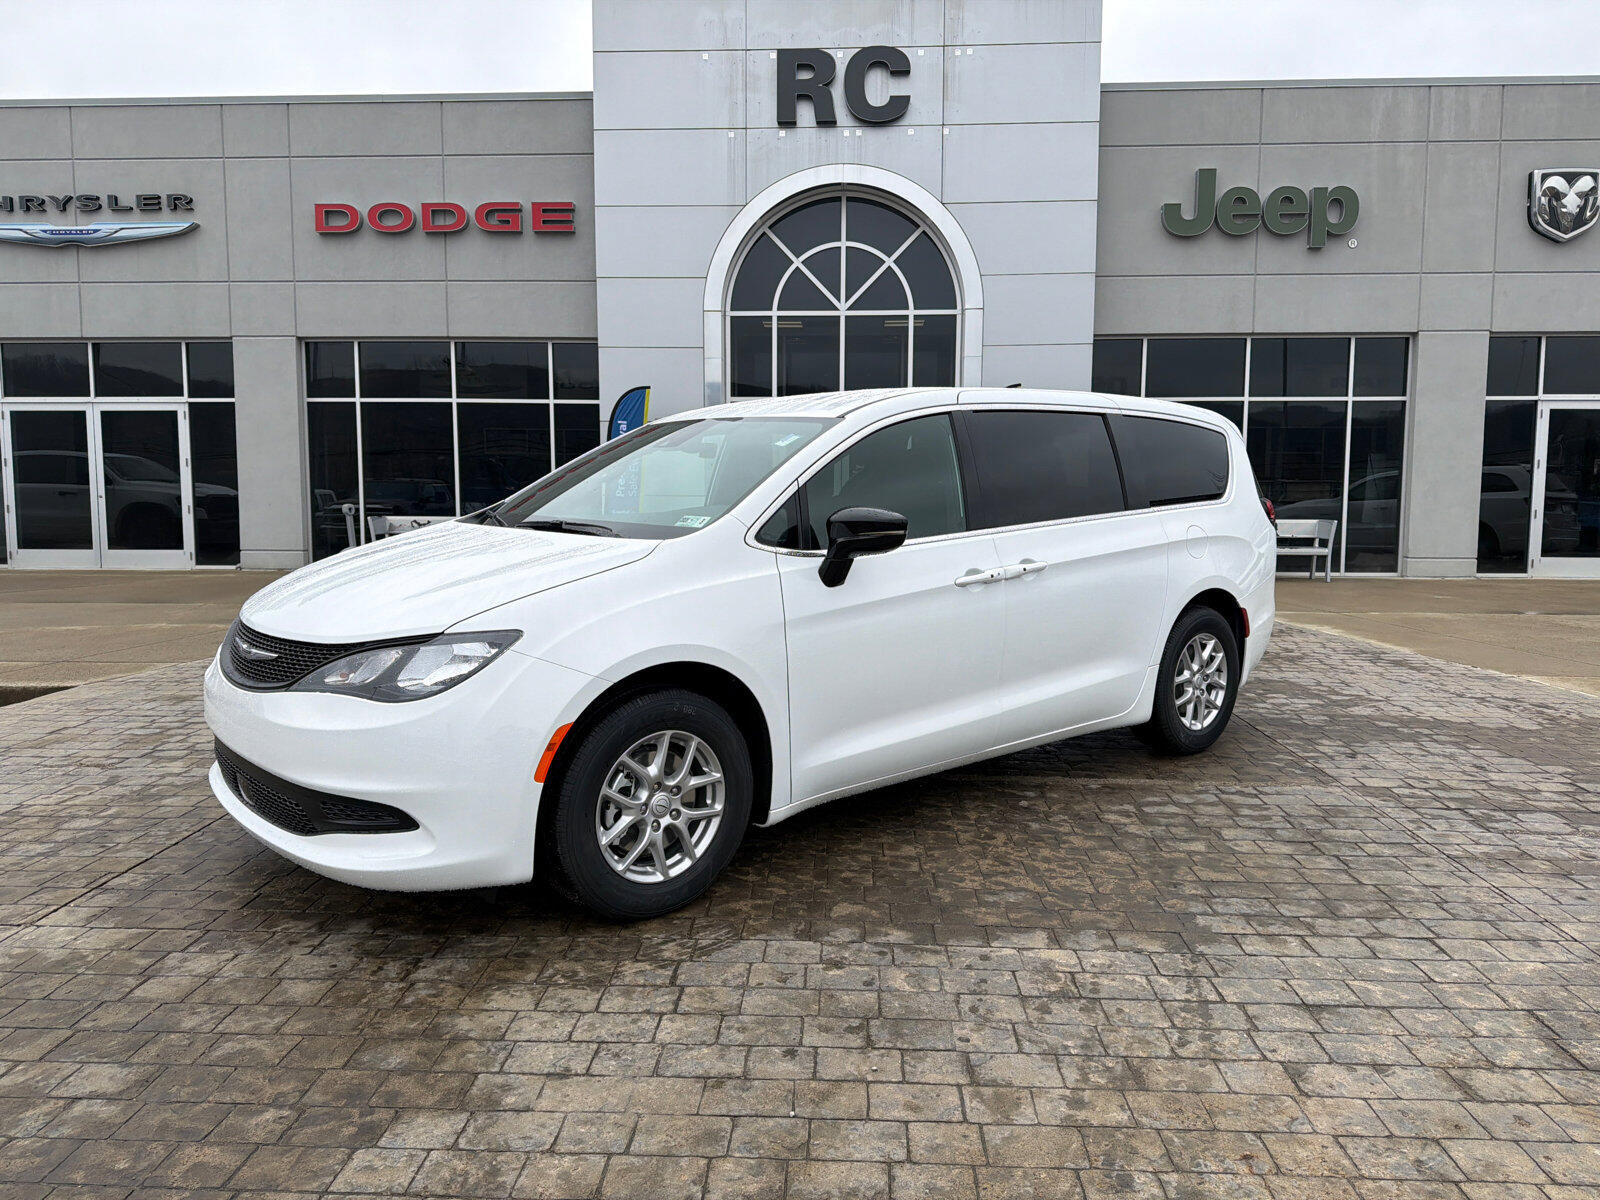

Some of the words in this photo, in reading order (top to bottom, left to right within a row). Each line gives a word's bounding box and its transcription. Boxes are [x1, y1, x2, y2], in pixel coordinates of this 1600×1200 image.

[775, 45, 911, 127] RC
[314, 201, 576, 234] DODGE
[1160, 168, 1361, 250] Jeep
